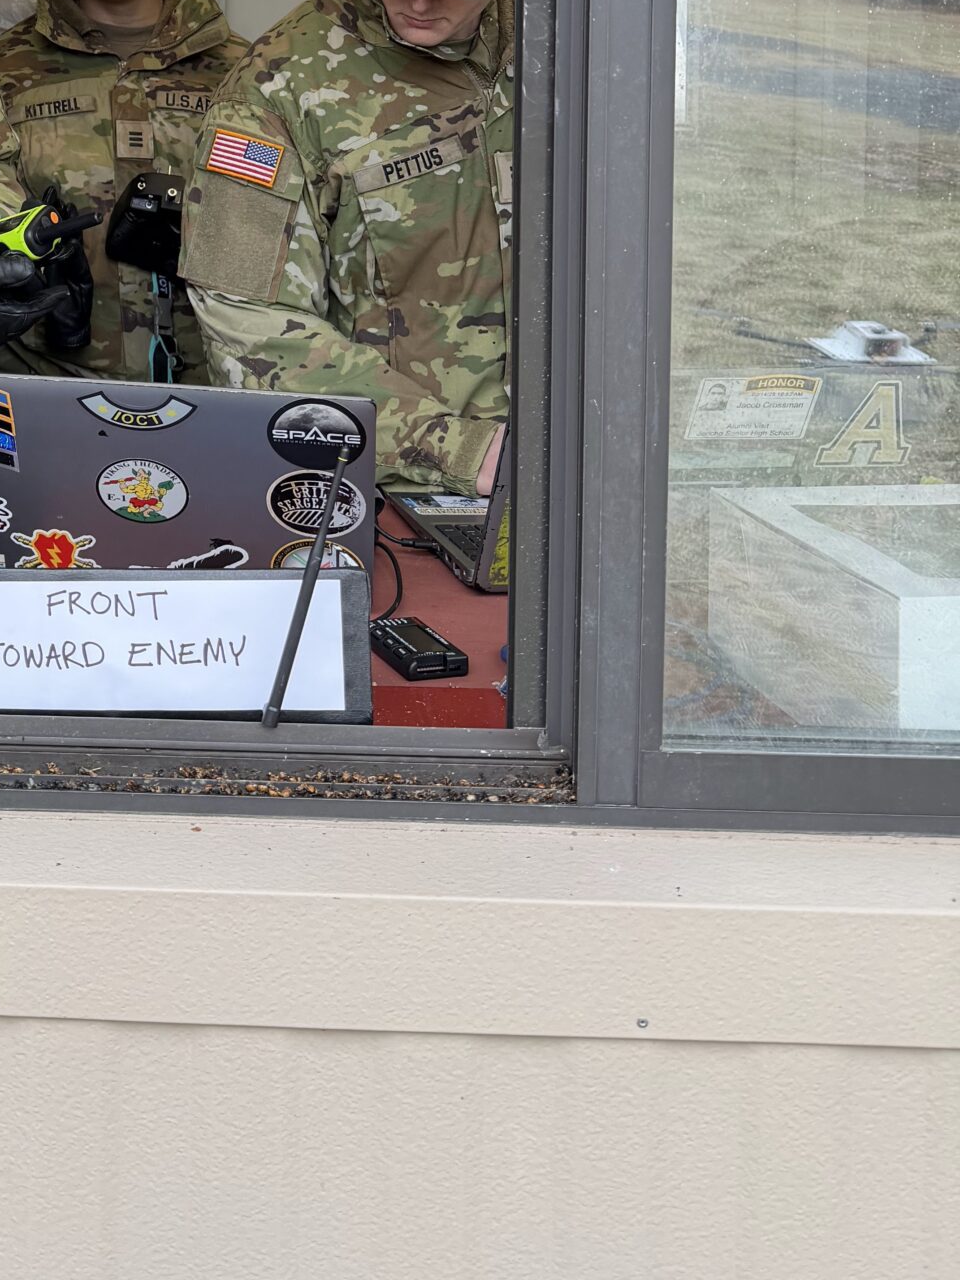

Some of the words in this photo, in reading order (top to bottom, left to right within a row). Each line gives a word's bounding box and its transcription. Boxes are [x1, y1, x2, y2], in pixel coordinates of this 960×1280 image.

[24, 97, 81, 119] KITTRELL
[165, 92, 211, 112] U.S.AR
[382, 147, 444, 183] PETTUS
[758, 378, 805, 388] HONOR
[113, 410, 160, 426] IOCT
[814, 380, 912, 467] A
[272, 426, 361, 445] SPACE
[103, 462, 130, 480] VIKING
[292, 486, 328, 499] GRIL
[46, 590, 168, 620] FRONT
[127, 635, 247, 667] ENEMY
